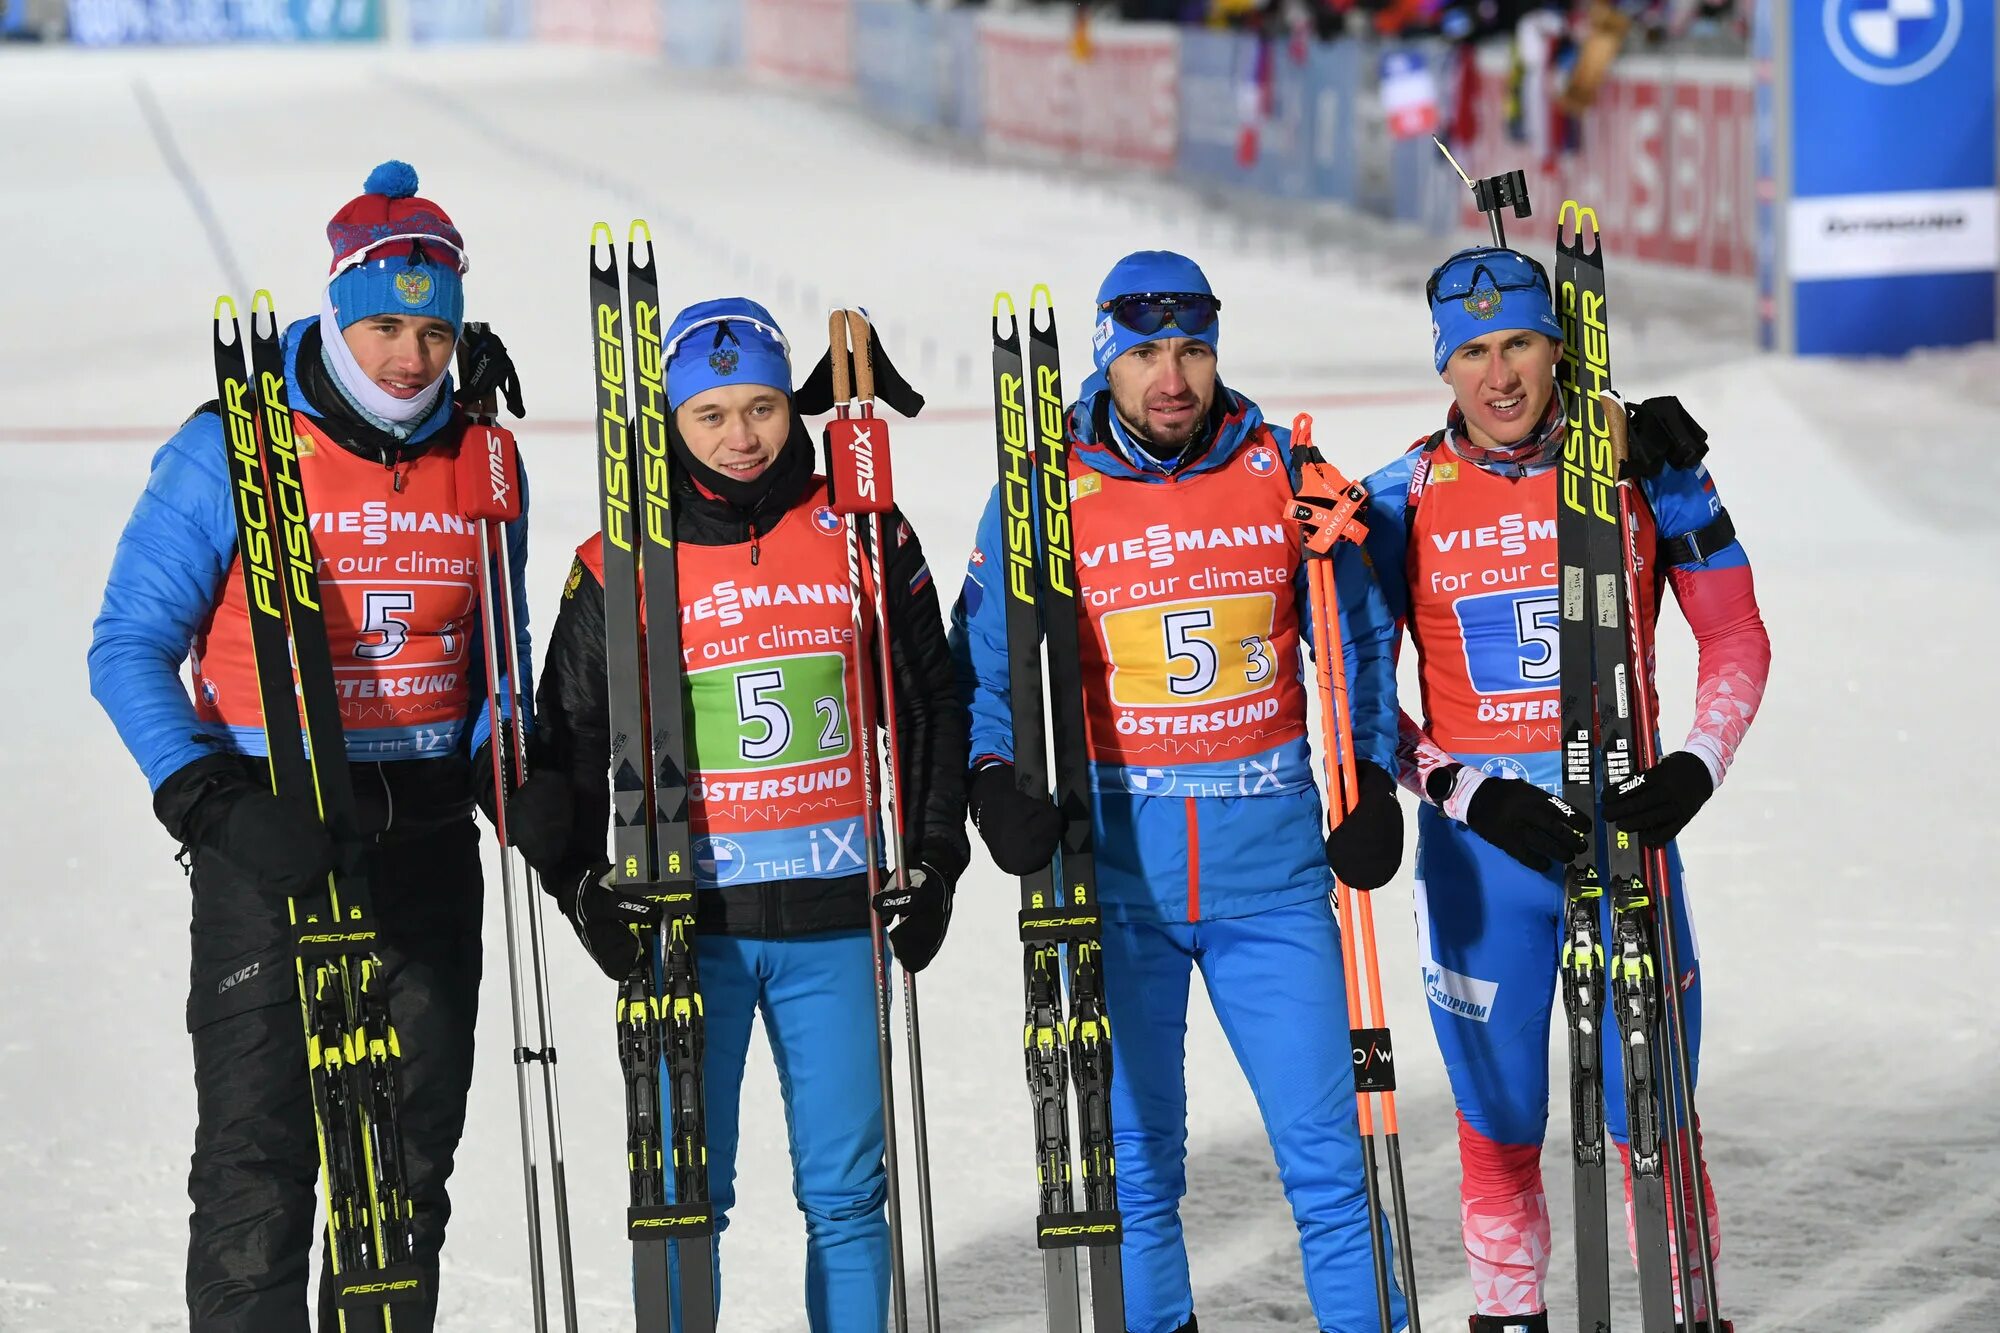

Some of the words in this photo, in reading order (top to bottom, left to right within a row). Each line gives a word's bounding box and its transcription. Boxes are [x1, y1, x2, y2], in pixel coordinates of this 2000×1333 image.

[470, 353, 491, 387] SWIX
[635, 300, 671, 549] FISCHER
[1581, 289, 1617, 525] FISCHER
[598, 303, 632, 553] FISCHER
[262, 371, 320, 612] FISCHER
[1000, 372, 1035, 606] FISCHER
[1037, 364, 1074, 598] FISCHER
[1410, 456, 1430, 498] SWIX
[224, 377, 281, 620] FISCHER
[1079, 523, 1285, 569] VIESSMANN
[337, 556, 388, 573] our
[1129, 576, 1180, 600] our
[1188, 565, 1288, 591] climate
[1430, 571, 1473, 593] for
[1481, 564, 1531, 585] our
[355, 591, 414, 661] 5
[702, 634, 751, 660] our
[757, 624, 852, 650] climate
[1512, 595, 1561, 682] 5
[1162, 608, 1219, 697] 5
[1240, 635, 1271, 683] 3
[735, 668, 793, 760] 5
[815, 697, 846, 750] 2
[1115, 698, 1279, 735] ÖSTERSUND
[1477, 698, 1561, 722] ÖSTER
[688, 766, 852, 803] ÖSTERSUND
[1238, 751, 1287, 796] iX
[1485, 759, 1522, 774] BMW
[694, 839, 737, 853] BMW
[752, 857, 808, 878] THE
[809, 822, 865, 873] iX
[1616, 830, 1629, 850] 3D
[626, 858, 639, 878] 3D
[669, 854, 681, 875] 3D
[1074, 886, 1086, 905] 3D
[298, 931, 376, 944] FISCHER
[1021, 917, 1097, 929] FISCHER
[1436, 990, 1488, 1018] GAZPROM
[631, 1215, 708, 1229] FISCHER
[1040, 1224, 1117, 1237] FISCHER
[341, 1279, 419, 1296] FISCHER
